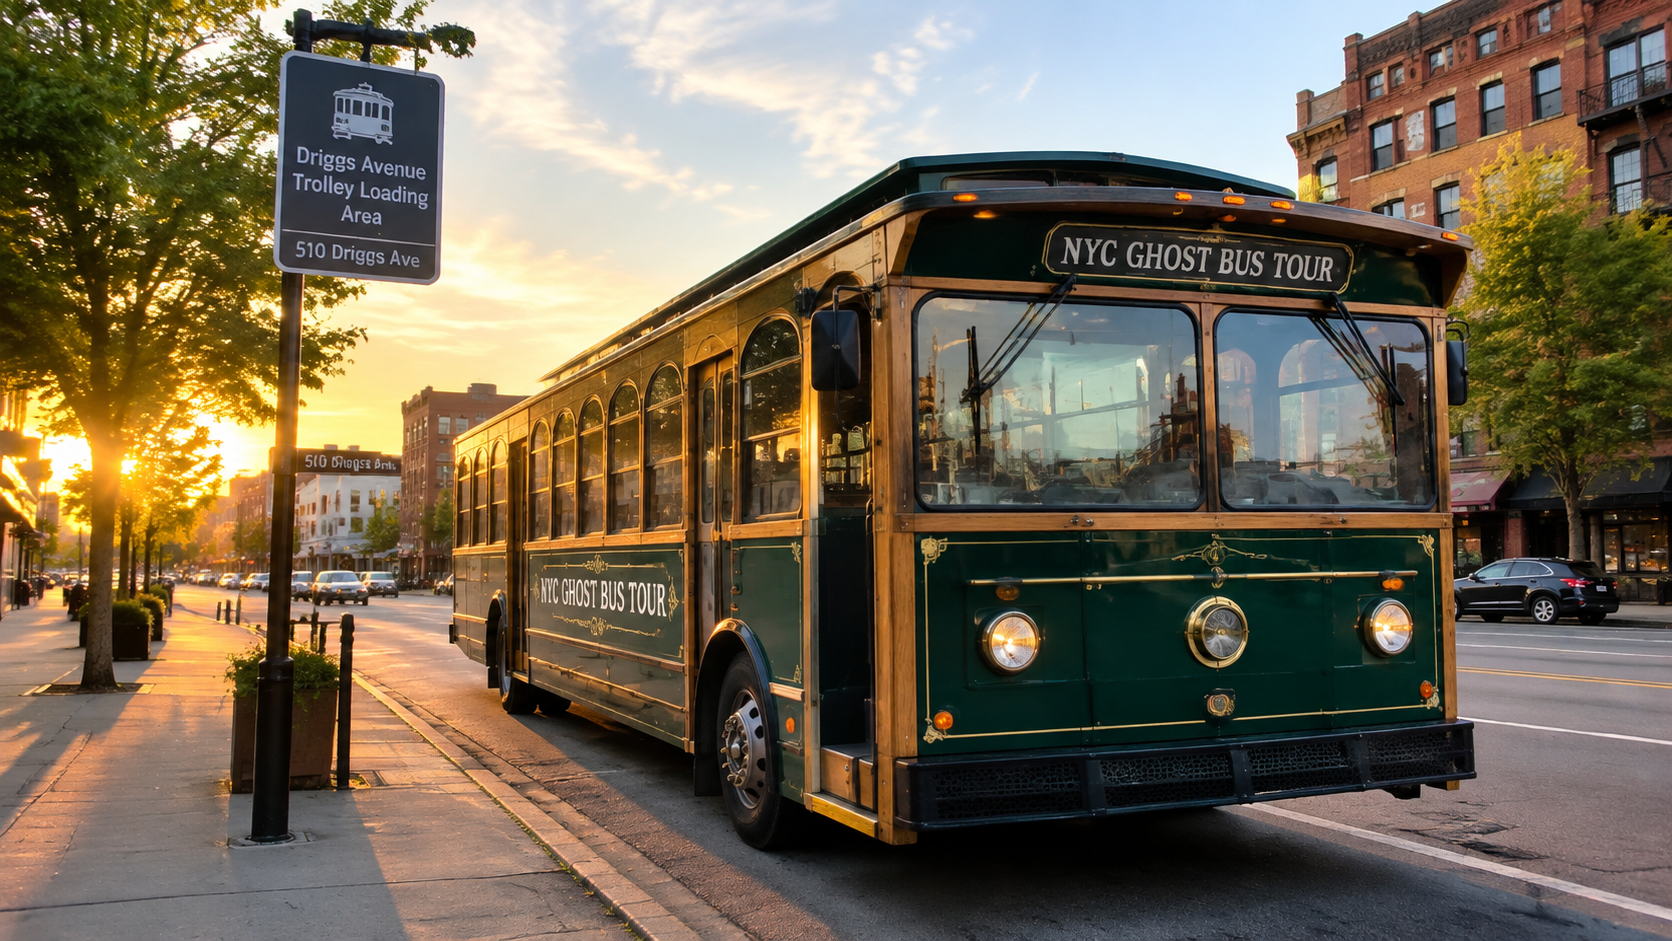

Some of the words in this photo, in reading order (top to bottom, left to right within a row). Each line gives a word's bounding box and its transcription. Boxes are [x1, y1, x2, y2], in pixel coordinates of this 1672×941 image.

[296, 146, 356, 172] Driggs
[361, 155, 427, 181] Avenue
[292, 172, 355, 200] Trolley
[360, 181, 429, 210] Loading
[340, 205, 383, 226] Area
[295, 241, 327, 259] 510
[332, 244, 385, 267] Driggs
[389, 250, 421, 268] Ave
[1060, 236, 1118, 268] NYC
[1126, 240, 1212, 274] GHOST
[1217, 248, 1265, 278] BUS
[1273, 252, 1335, 283] TOUR
[540, 577, 559, 605] NYC
[561, 578, 598, 609] GHOST
[600, 580, 625, 613] BUS
[628, 581, 667, 617] TOUR
